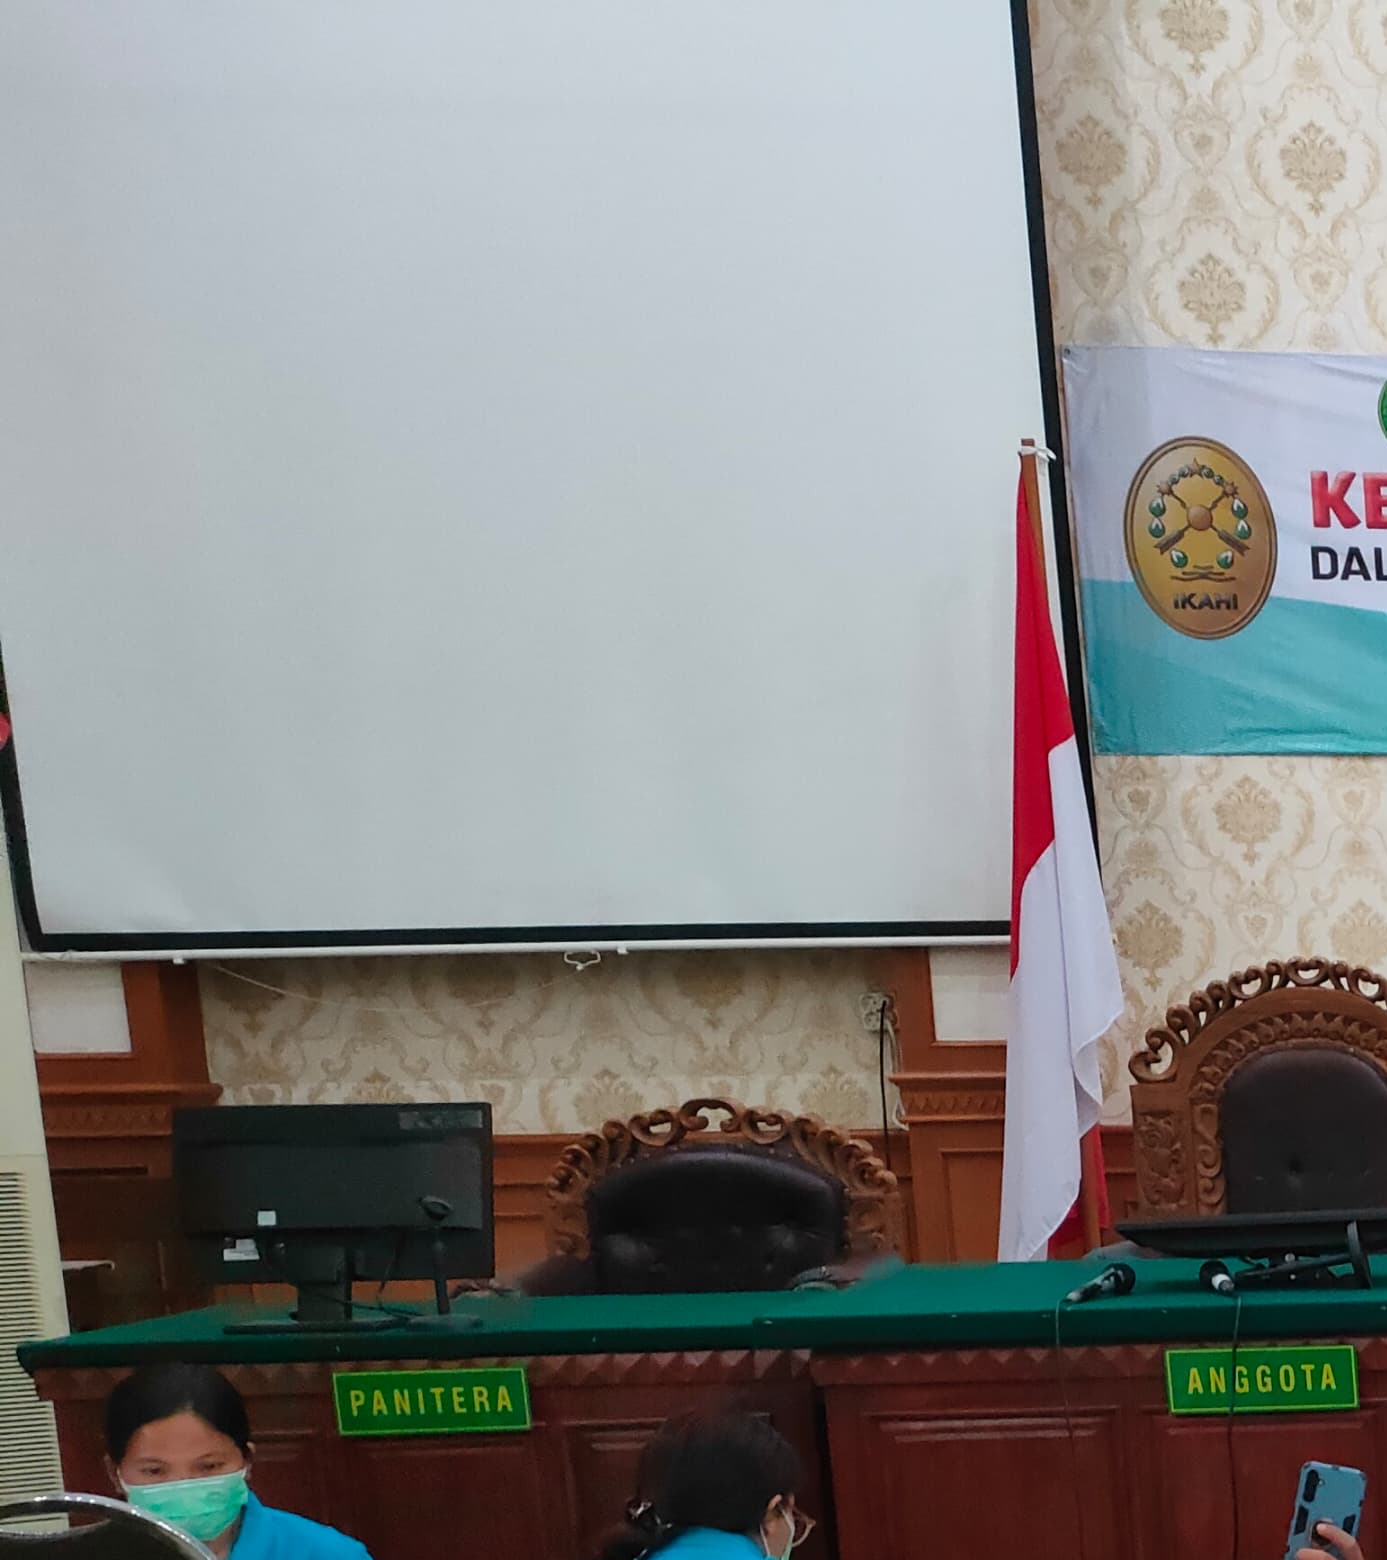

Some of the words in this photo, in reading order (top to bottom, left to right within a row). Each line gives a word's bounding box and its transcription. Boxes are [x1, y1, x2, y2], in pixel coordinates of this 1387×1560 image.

[1174, 592, 1238, 610] IKAHI
[1187, 1364, 1337, 1394] ANGGOTA
[349, 1385, 514, 1417] PANITERA
